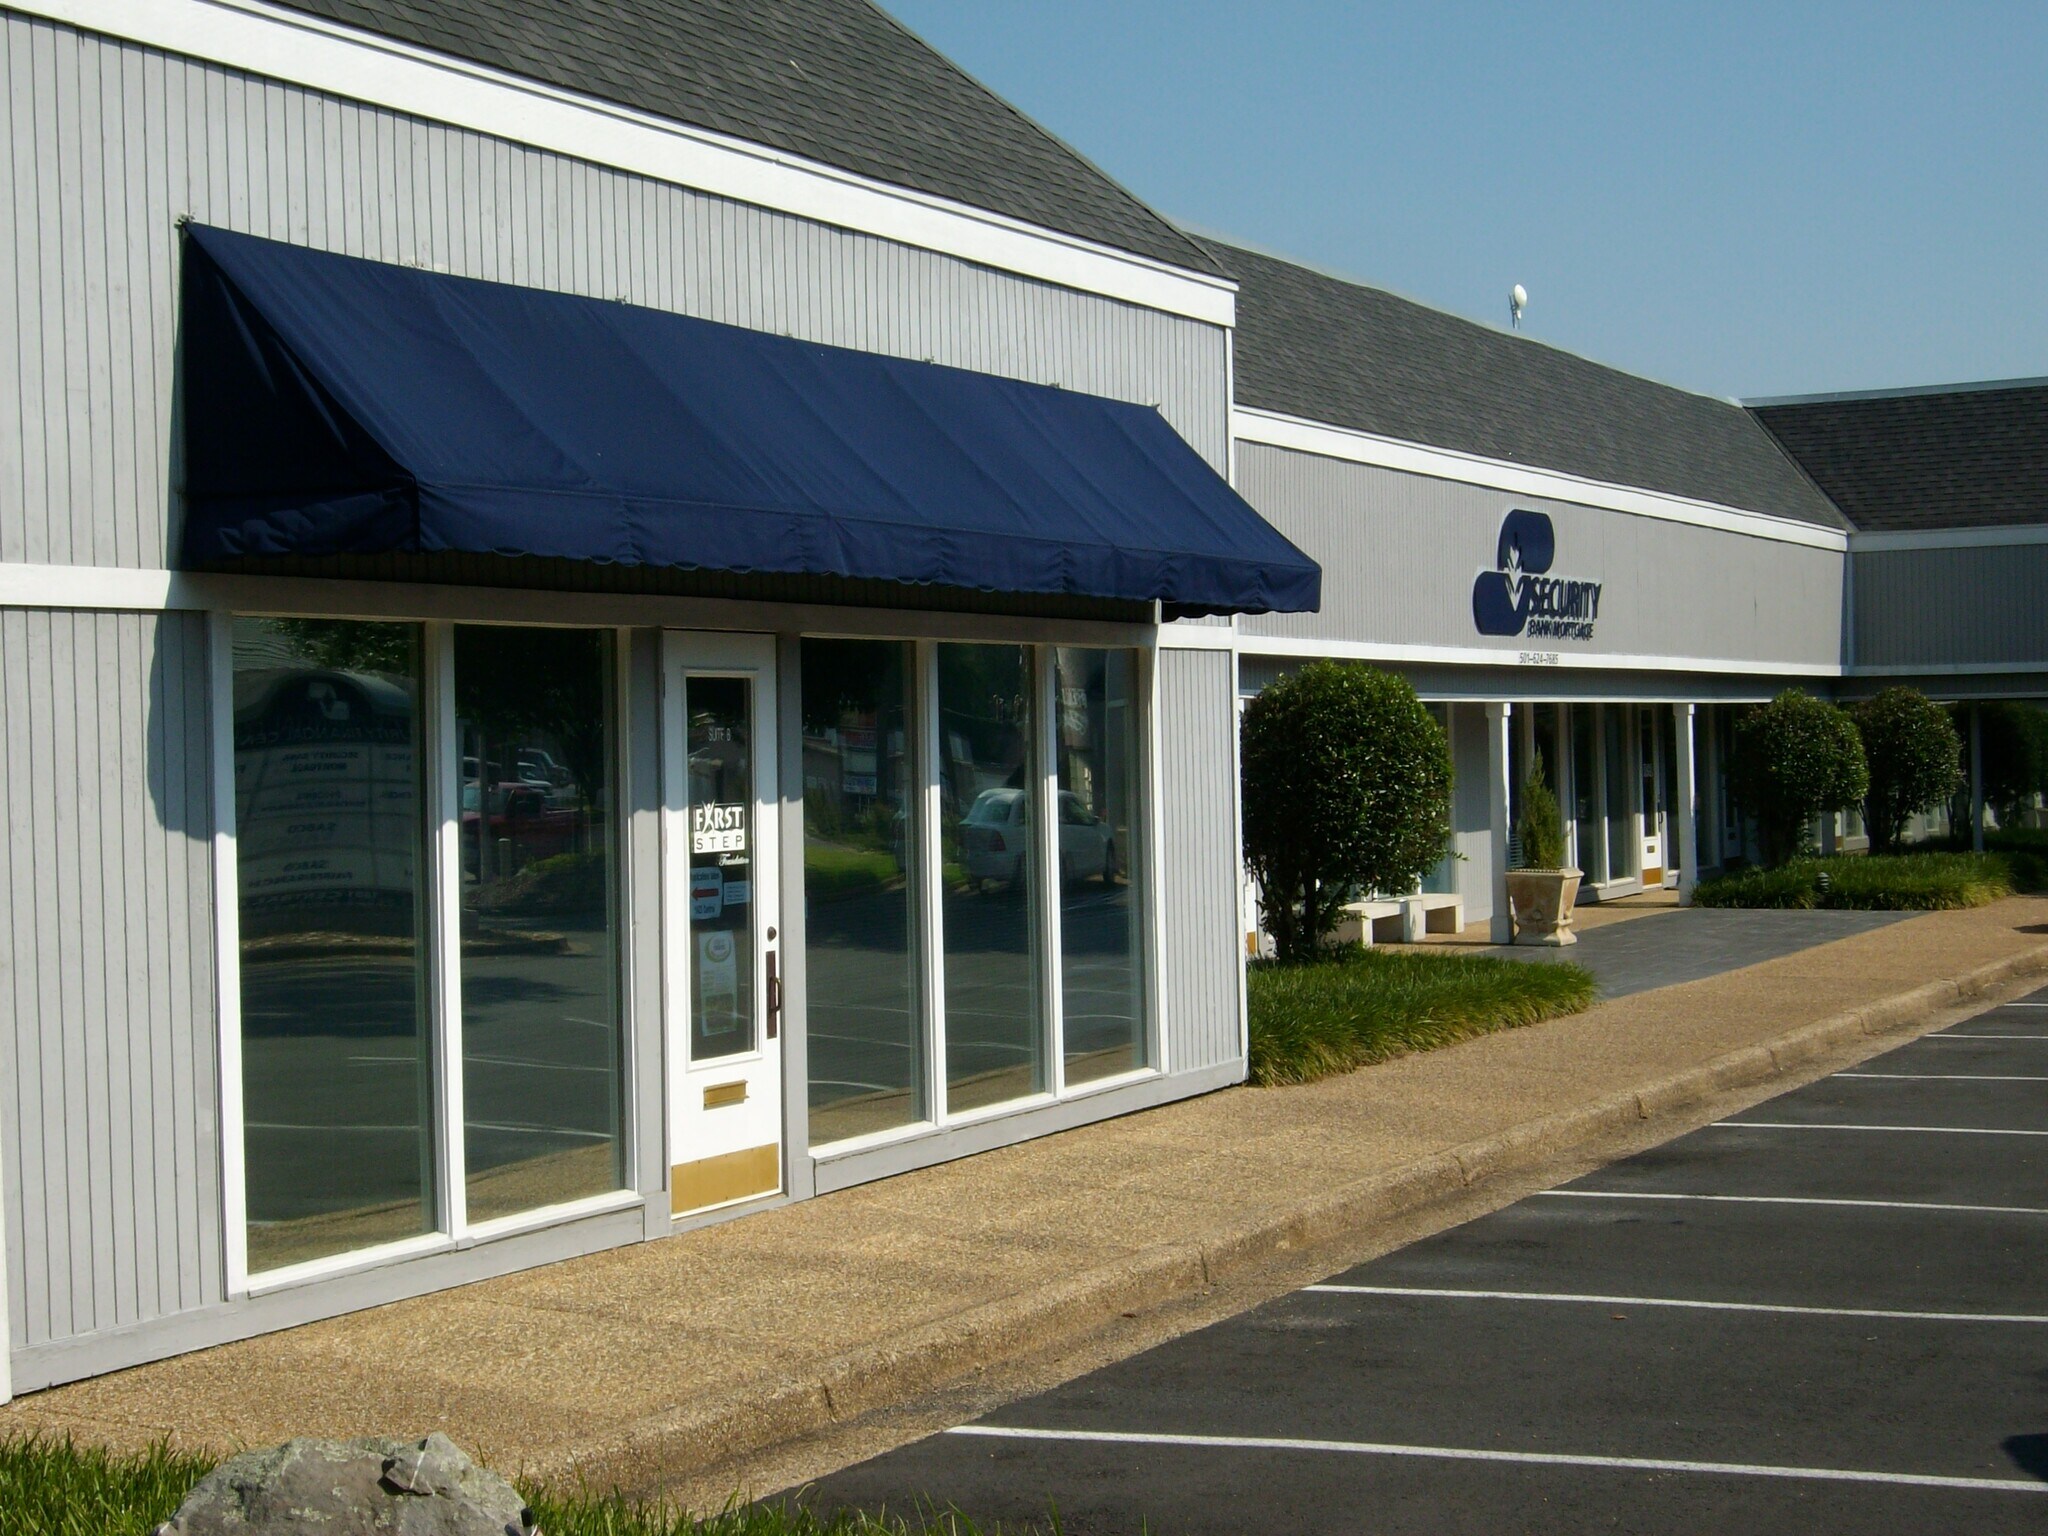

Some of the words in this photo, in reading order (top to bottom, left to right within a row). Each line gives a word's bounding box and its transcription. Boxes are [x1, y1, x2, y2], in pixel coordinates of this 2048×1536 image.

[1529, 576, 1602, 622] SECURITY
[1527, 619, 1552, 639] BANK
[1553, 620, 1594, 642] MORTGAGE
[695, 800, 743, 834] FIRST
[696, 834, 743, 850] STEP
